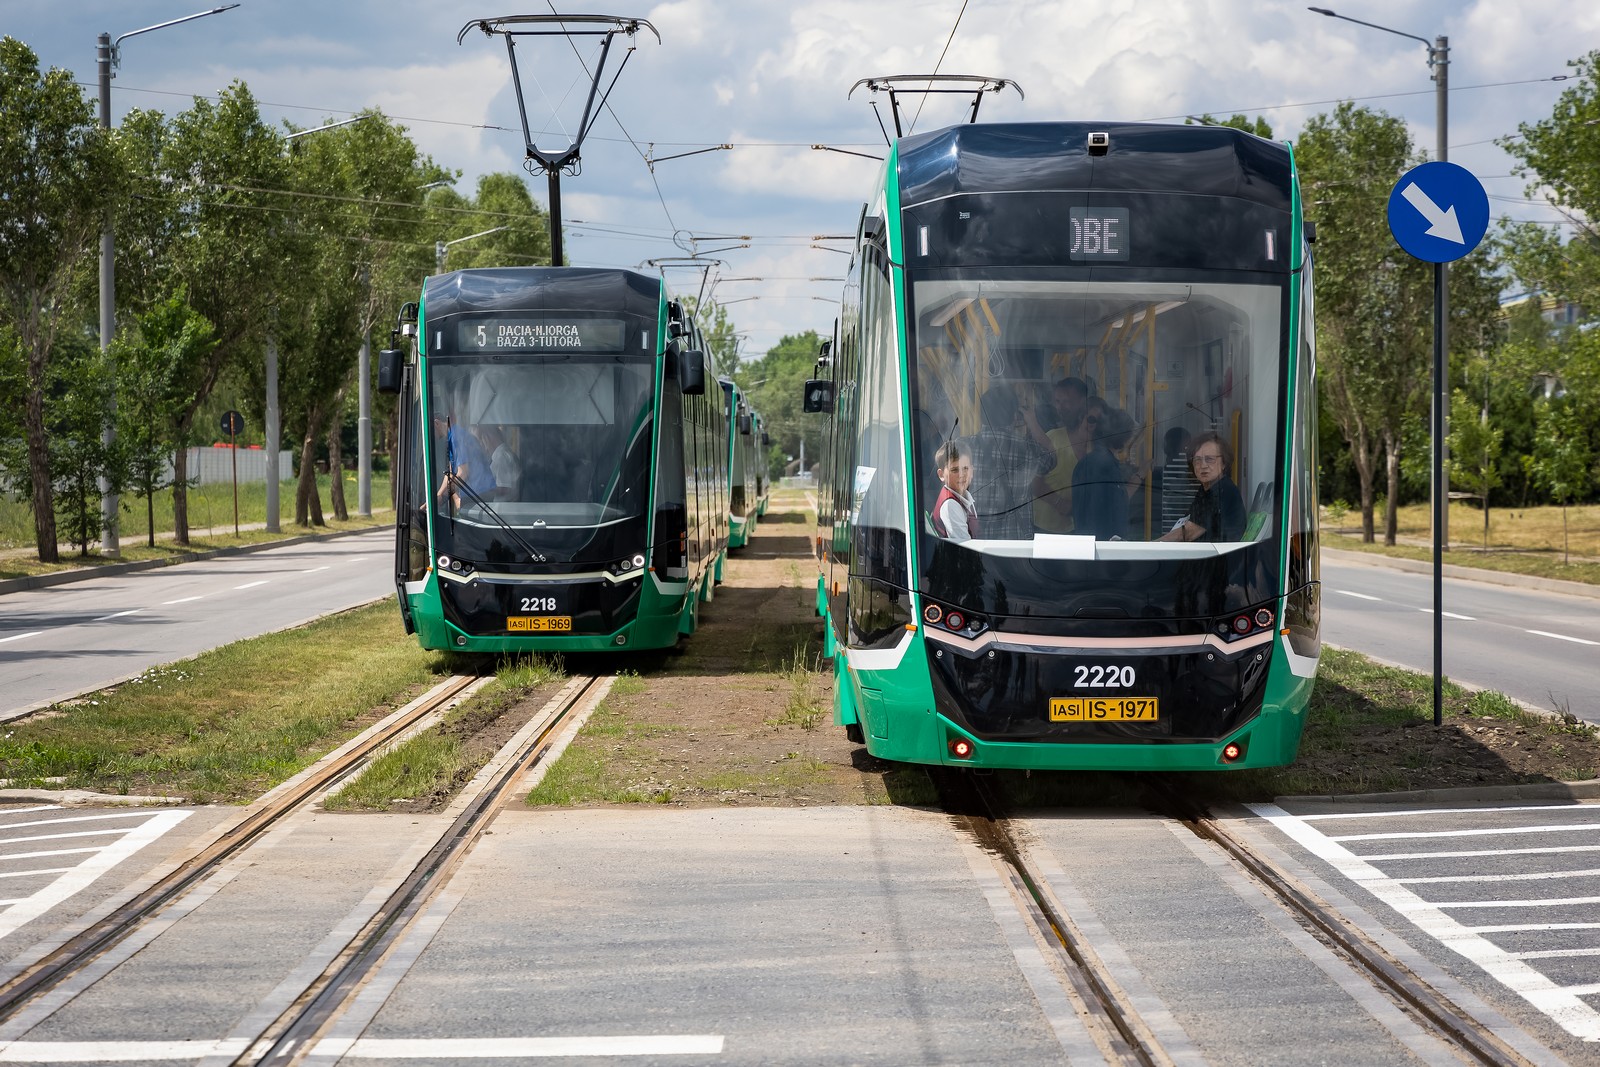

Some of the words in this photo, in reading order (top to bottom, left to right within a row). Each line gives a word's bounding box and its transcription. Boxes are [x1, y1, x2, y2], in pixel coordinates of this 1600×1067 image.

[477, 325, 487, 347] 5
[498, 325, 579, 336] DACIA-N.IORGA
[497, 336, 526, 347] BAZA
[528, 336, 582, 347] 3-TUTORA
[520, 597, 557, 612] 2218
[509, 620, 526, 628] IASI
[529, 618, 570, 630] IS-1969
[1073, 665, 1136, 688] 2220
[1053, 704, 1080, 716] IASI
[1088, 700, 1155, 719] IS-1971
